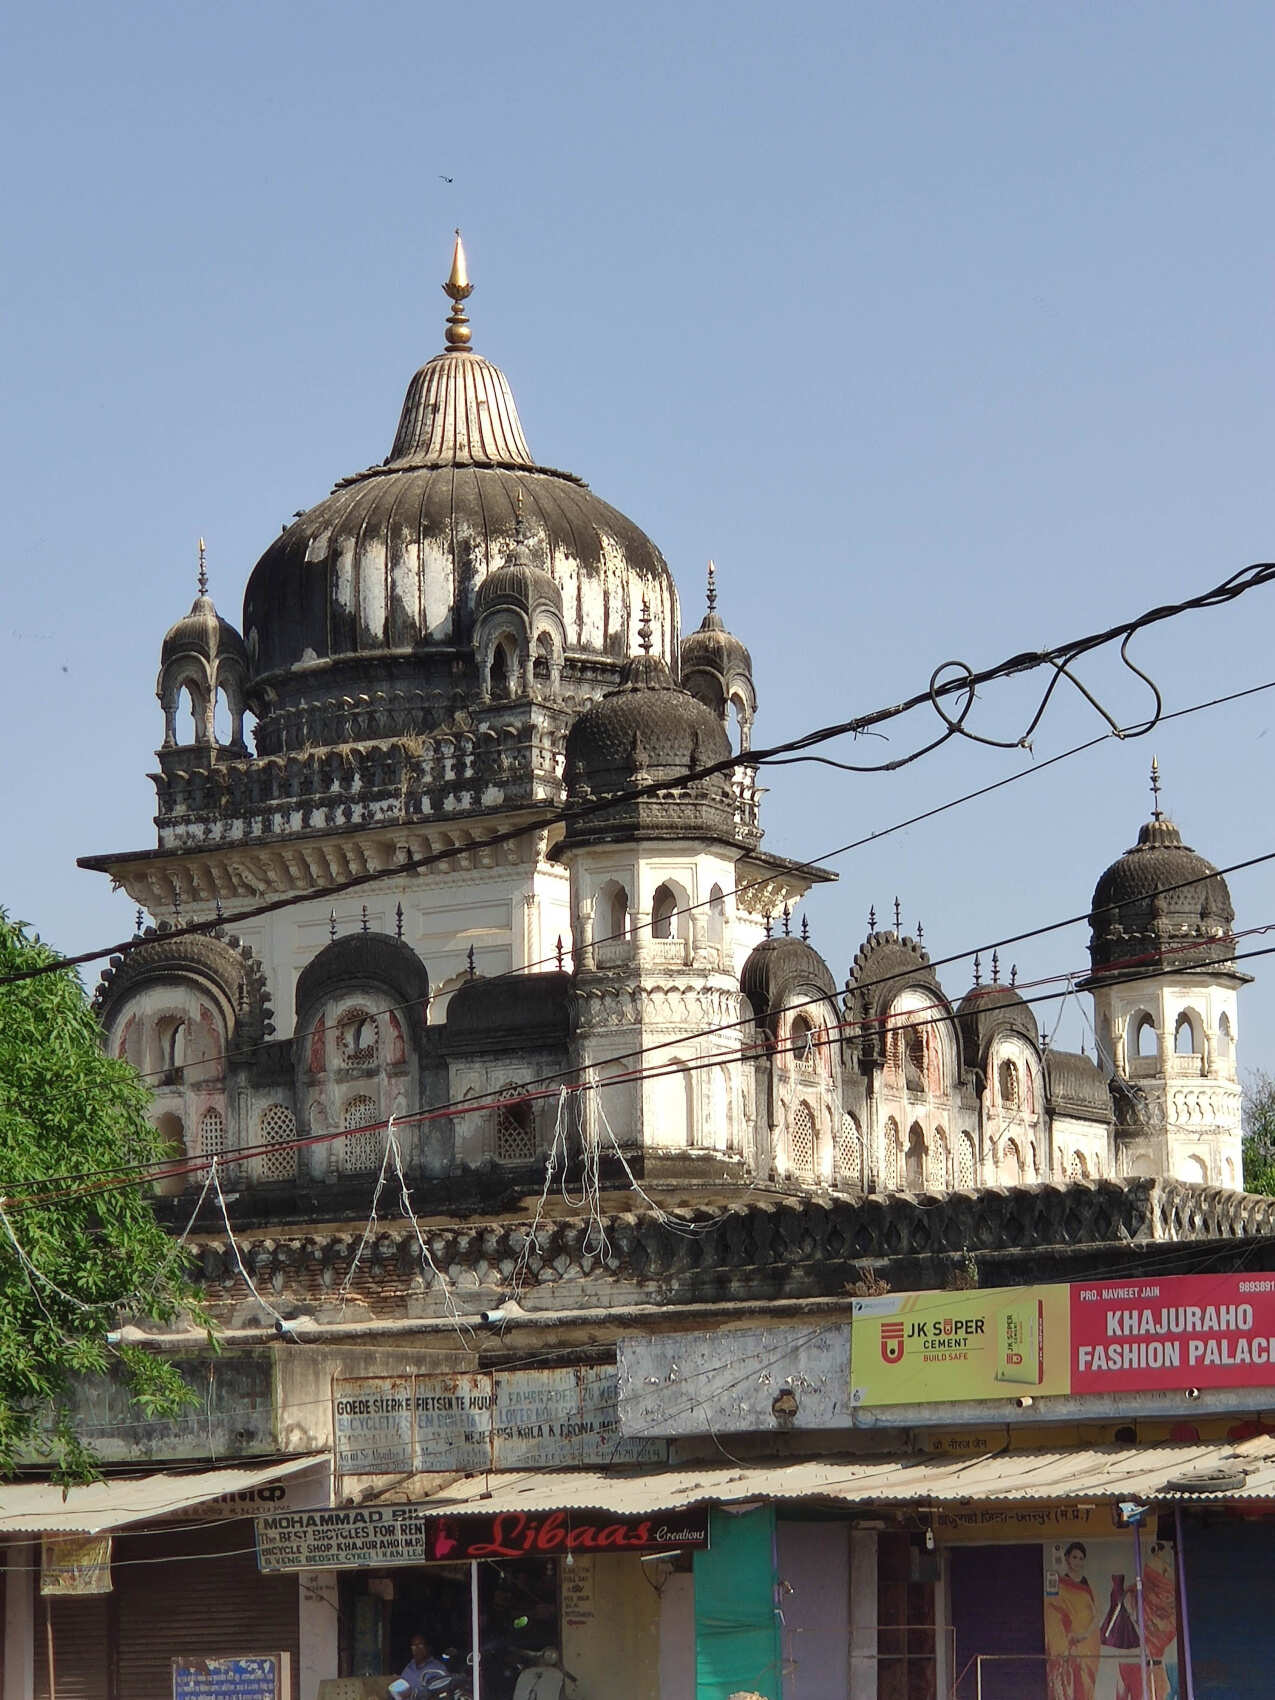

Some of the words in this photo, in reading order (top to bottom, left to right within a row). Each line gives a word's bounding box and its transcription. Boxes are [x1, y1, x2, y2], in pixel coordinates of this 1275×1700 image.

[1080, 1290, 1100, 1301] PRO.
[1102, 1287, 1138, 1300] NAVNEET
[1141, 1286, 1160, 1298] JAIN
[907, 1321, 928, 1338] JK
[932, 1318, 985, 1337] SUPER
[1106, 1304, 1253, 1337] KHAJURAHO
[923, 1337, 968, 1349] CEMENT
[923, 1353, 947, 1362] BUILD
[949, 1352, 968, 1361] SAFE
[1078, 1341, 1181, 1372] FASHION
[336, 1399, 371, 1416] GOEDE
[373, 1398, 412, 1413] STERKE
[263, 1511, 383, 1530] MOHAMMAD
[260, 1533, 277, 1545] The
[279, 1530, 308, 1544] BEST
[312, 1526, 369, 1541] BICYCLES
[374, 1524, 395, 1538] FOR
[467, 1511, 652, 1555] Libaas
[655, 1526, 705, 1542] Creations
[261, 1544, 302, 1556] BICYCLE
[307, 1542, 333, 1554] SHOP
